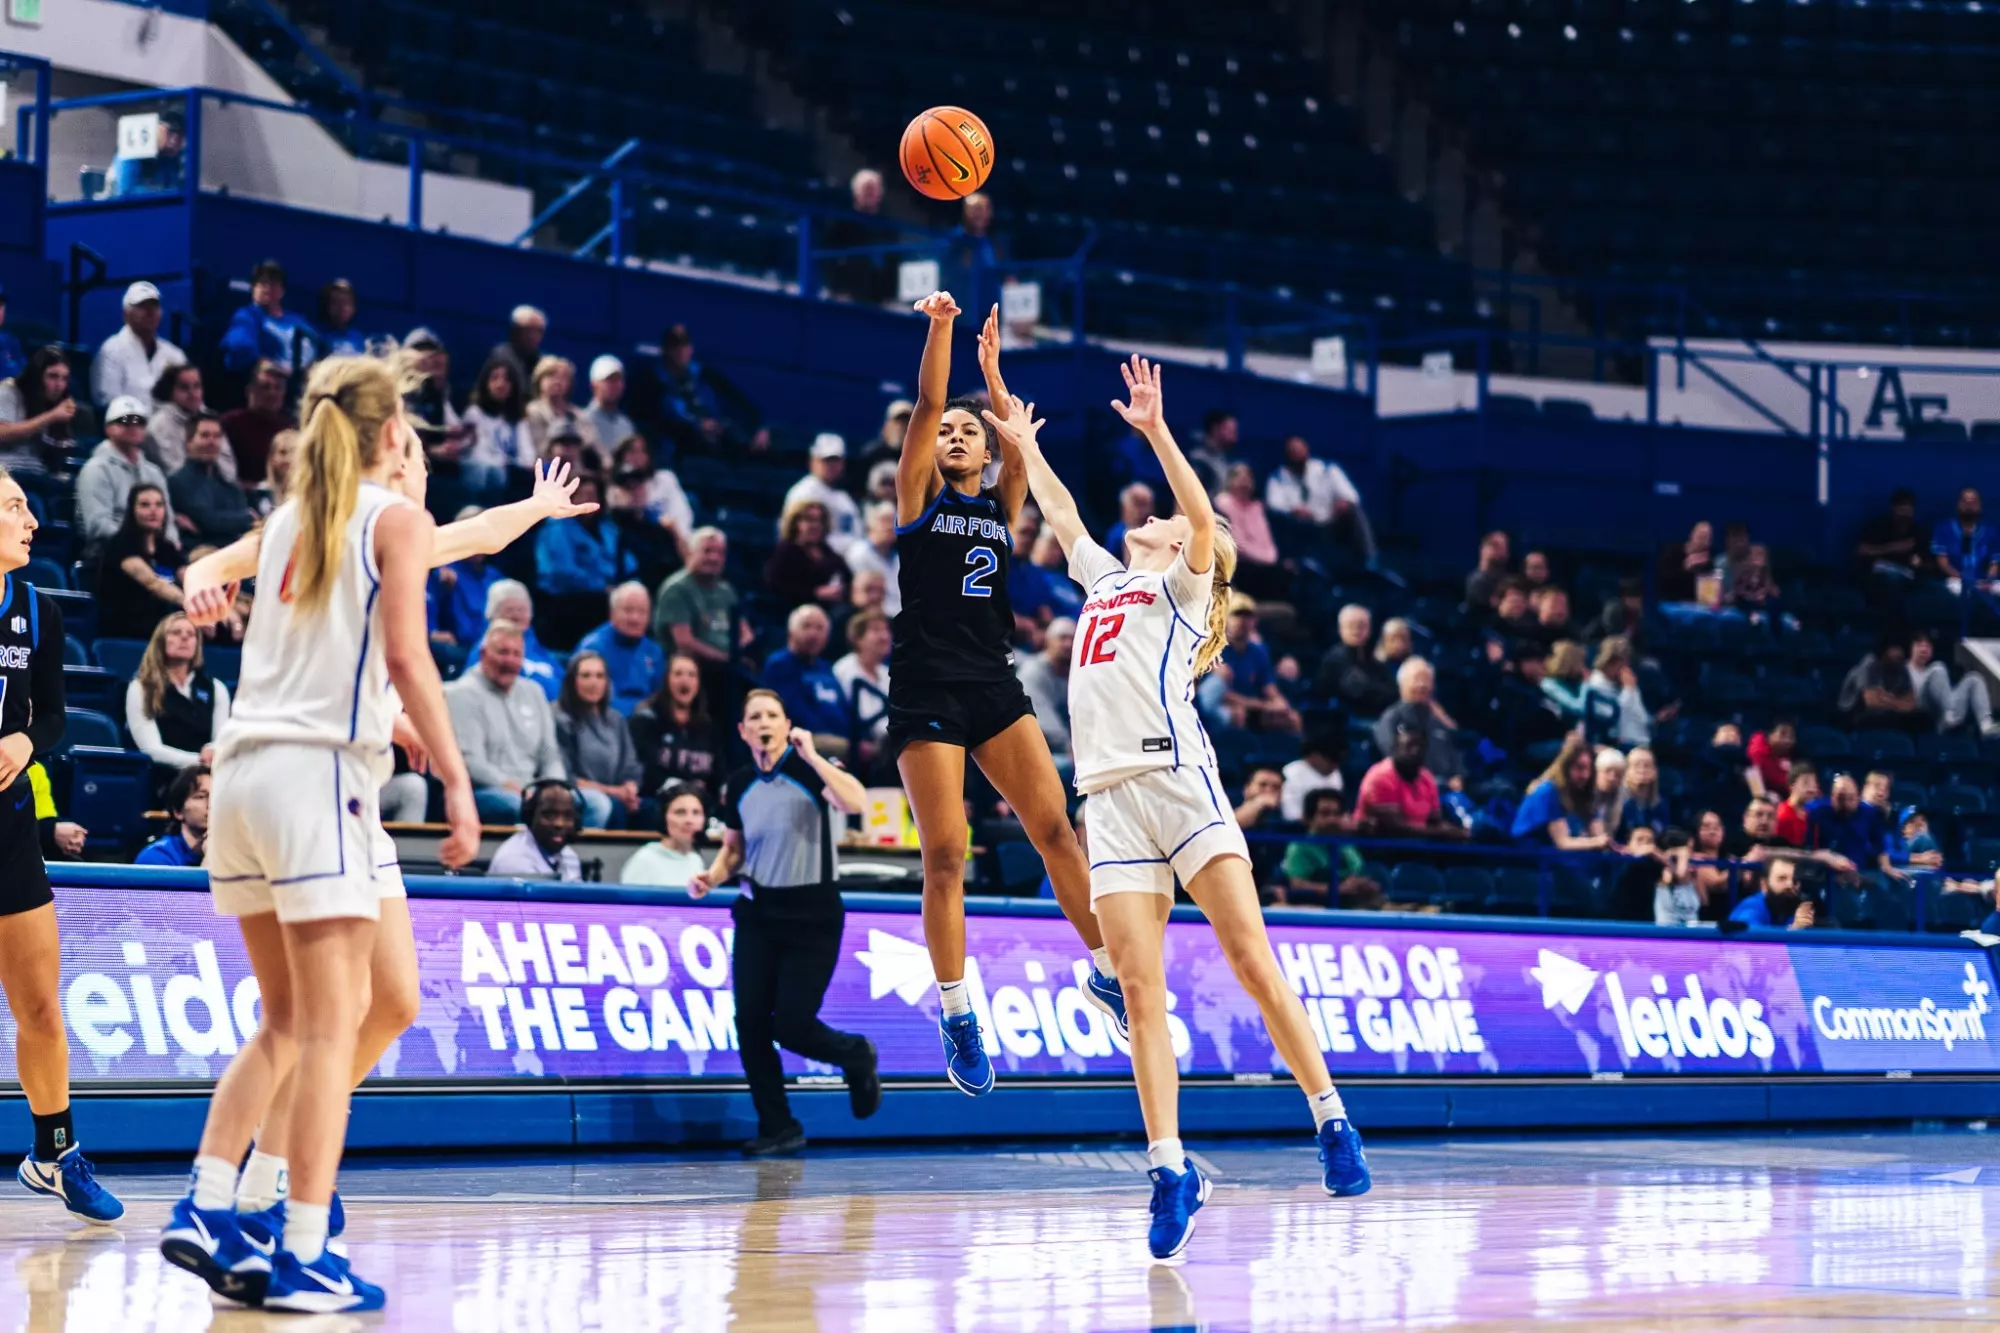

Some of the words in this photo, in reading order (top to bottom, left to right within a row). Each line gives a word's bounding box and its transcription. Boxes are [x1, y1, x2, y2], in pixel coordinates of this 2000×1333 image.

[957, 120, 990, 168] ELITE
[931, 513, 966, 535] AIR
[967, 516, 1008, 546] FOR
[961, 546, 998, 597] 2
[1079, 611, 1126, 668] 12
[461, 920, 660, 986] AHEAD
[679, 924, 735, 988] O
[1278, 942, 1403, 999] HEAD
[1406, 944, 1464, 1000] OF
[465, 986, 599, 1051] THE
[602, 986, 740, 1052] GAM
[964, 956, 1191, 1058] leids
[1355, 997, 1485, 1054] GAME
[1604, 971, 1776, 1058] leidos
